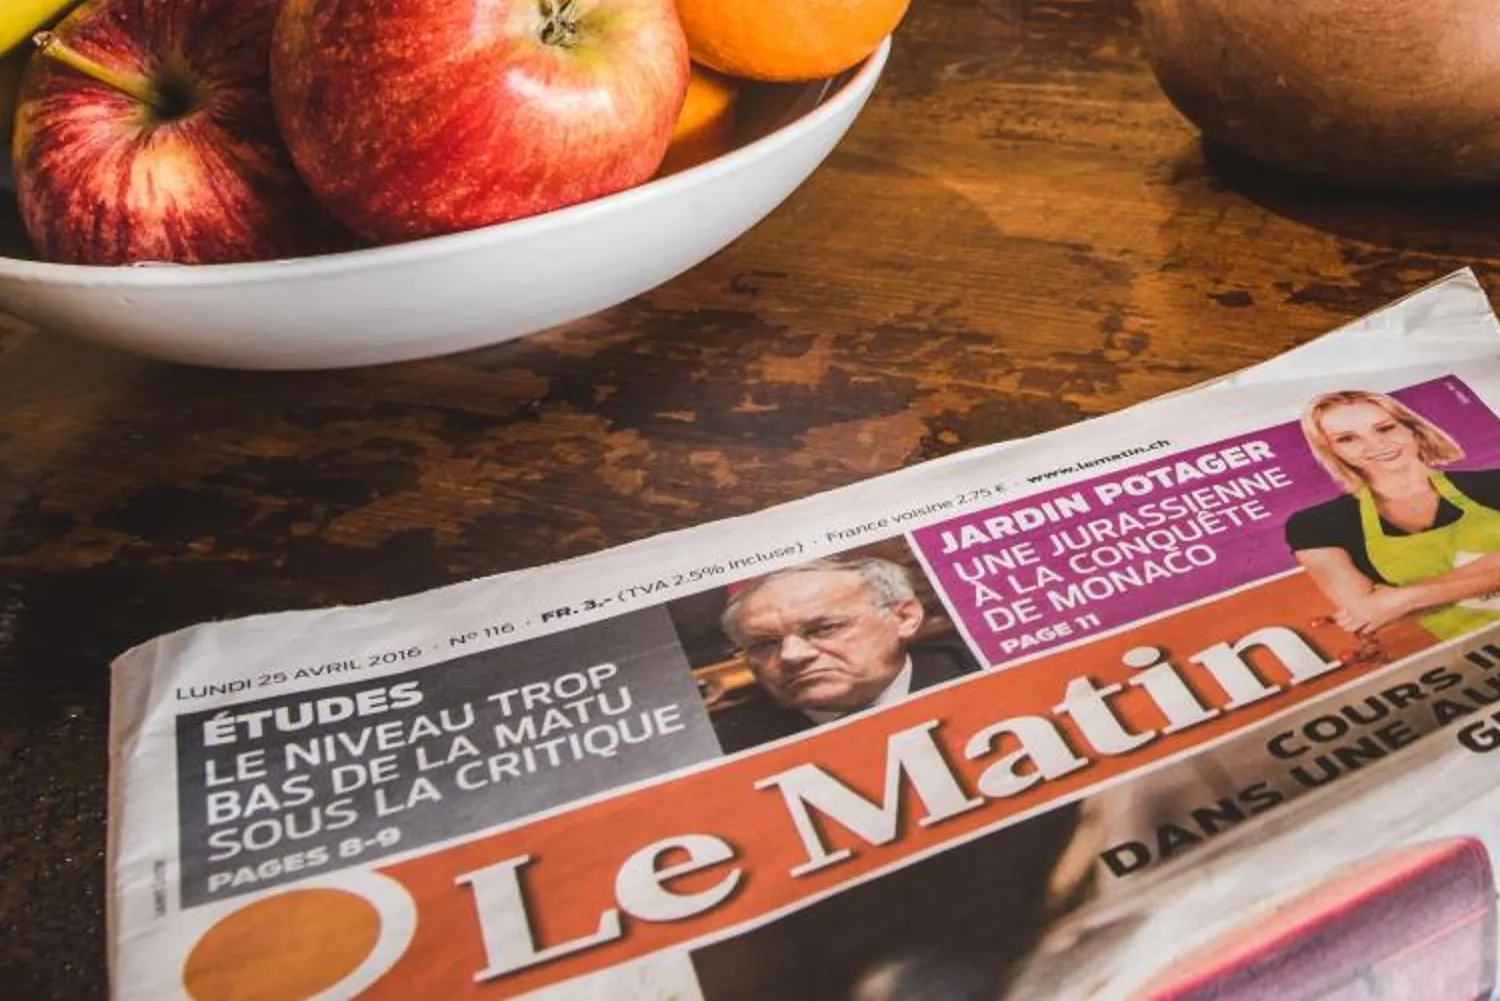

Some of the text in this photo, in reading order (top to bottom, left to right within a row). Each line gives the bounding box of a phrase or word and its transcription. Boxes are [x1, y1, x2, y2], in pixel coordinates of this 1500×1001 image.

[941, 440, 1276, 555] JARDIN POTAGER
[952, 466, 1293, 582] UNE JURASSIENNE
[968, 501, 1272, 608] À LA CONQUÊTE
[176, 679, 251, 700] LUNDI
[258, 672, 287, 687] 25
[293, 660, 362, 680] AVRIL
[367, 646, 422, 667] 2016
[482, 621, 515, 638] 116
[541, 605, 579, 623] FR.
[617, 579, 669, 603] (TVA
[728, 542, 804, 570] incluse)
[826, 517, 888, 543] France
[891, 499, 953, 523] voisine
[1027, 438, 1171, 483] www.lematin.ch
[983, 544, 1218, 633] DE MONACO
[999, 612, 1101, 654] PAGE 11
[203, 679, 424, 747] ÉTUDES
[204, 662, 618, 788] LE NIVEAU TROP
[206, 686, 633, 826] BAS DE LA MATU
[1266, 665, 1463, 761] COURS
[206, 703, 686, 862] SOUS LA CRITIQUE
[454, 624, 1343, 984] Le Matin
[1099, 781, 1285, 879] DANS
[1290, 720, 1422, 787] UNE
[207, 845, 329, 894] PAGES
[338, 826, 402, 858] 8-9
